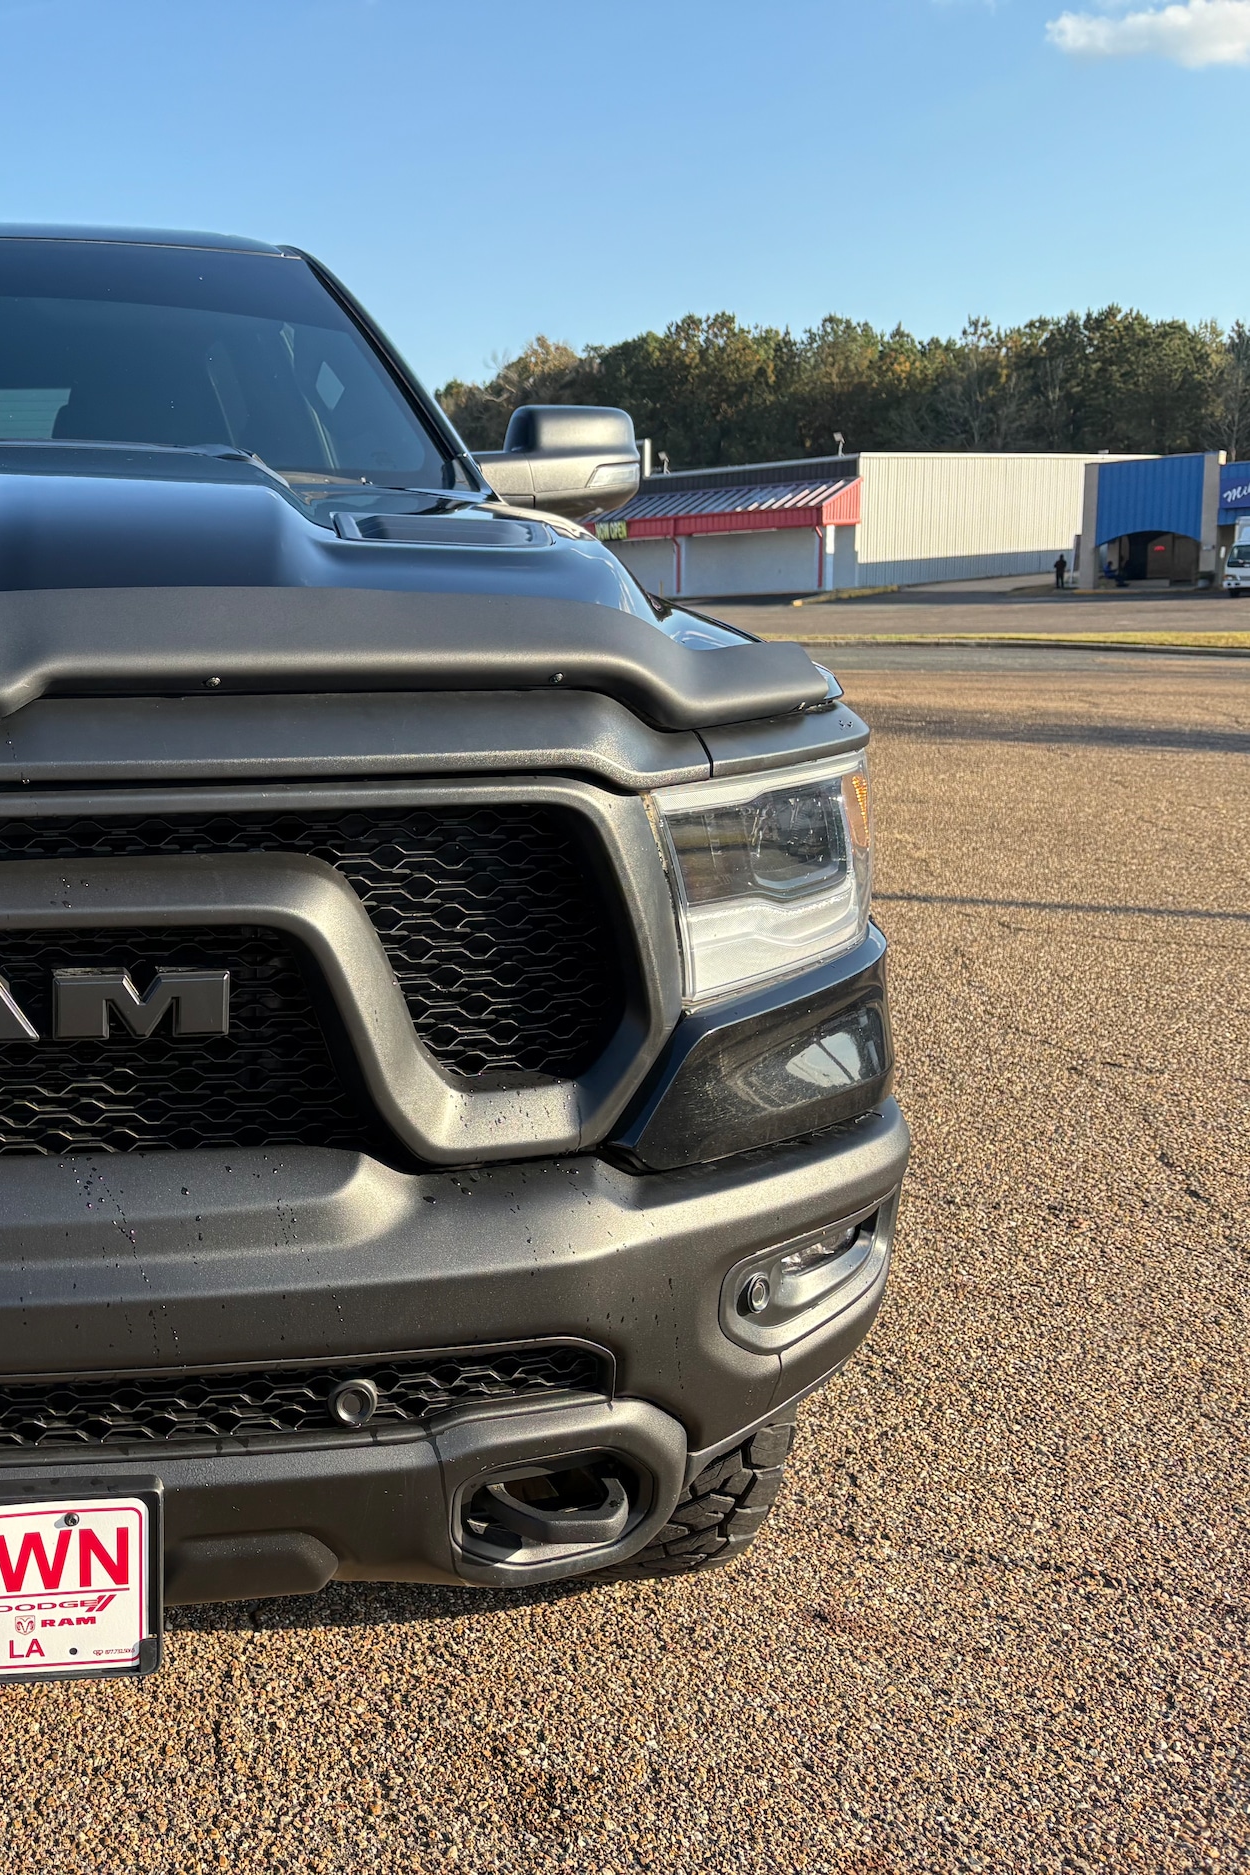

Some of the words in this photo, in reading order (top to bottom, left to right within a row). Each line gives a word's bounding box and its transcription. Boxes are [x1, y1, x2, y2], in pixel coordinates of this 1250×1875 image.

[610, 520, 627, 539] OPEN
[40, 1616, 96, 1628] RAM
[8, 1638, 45, 1658] LA
